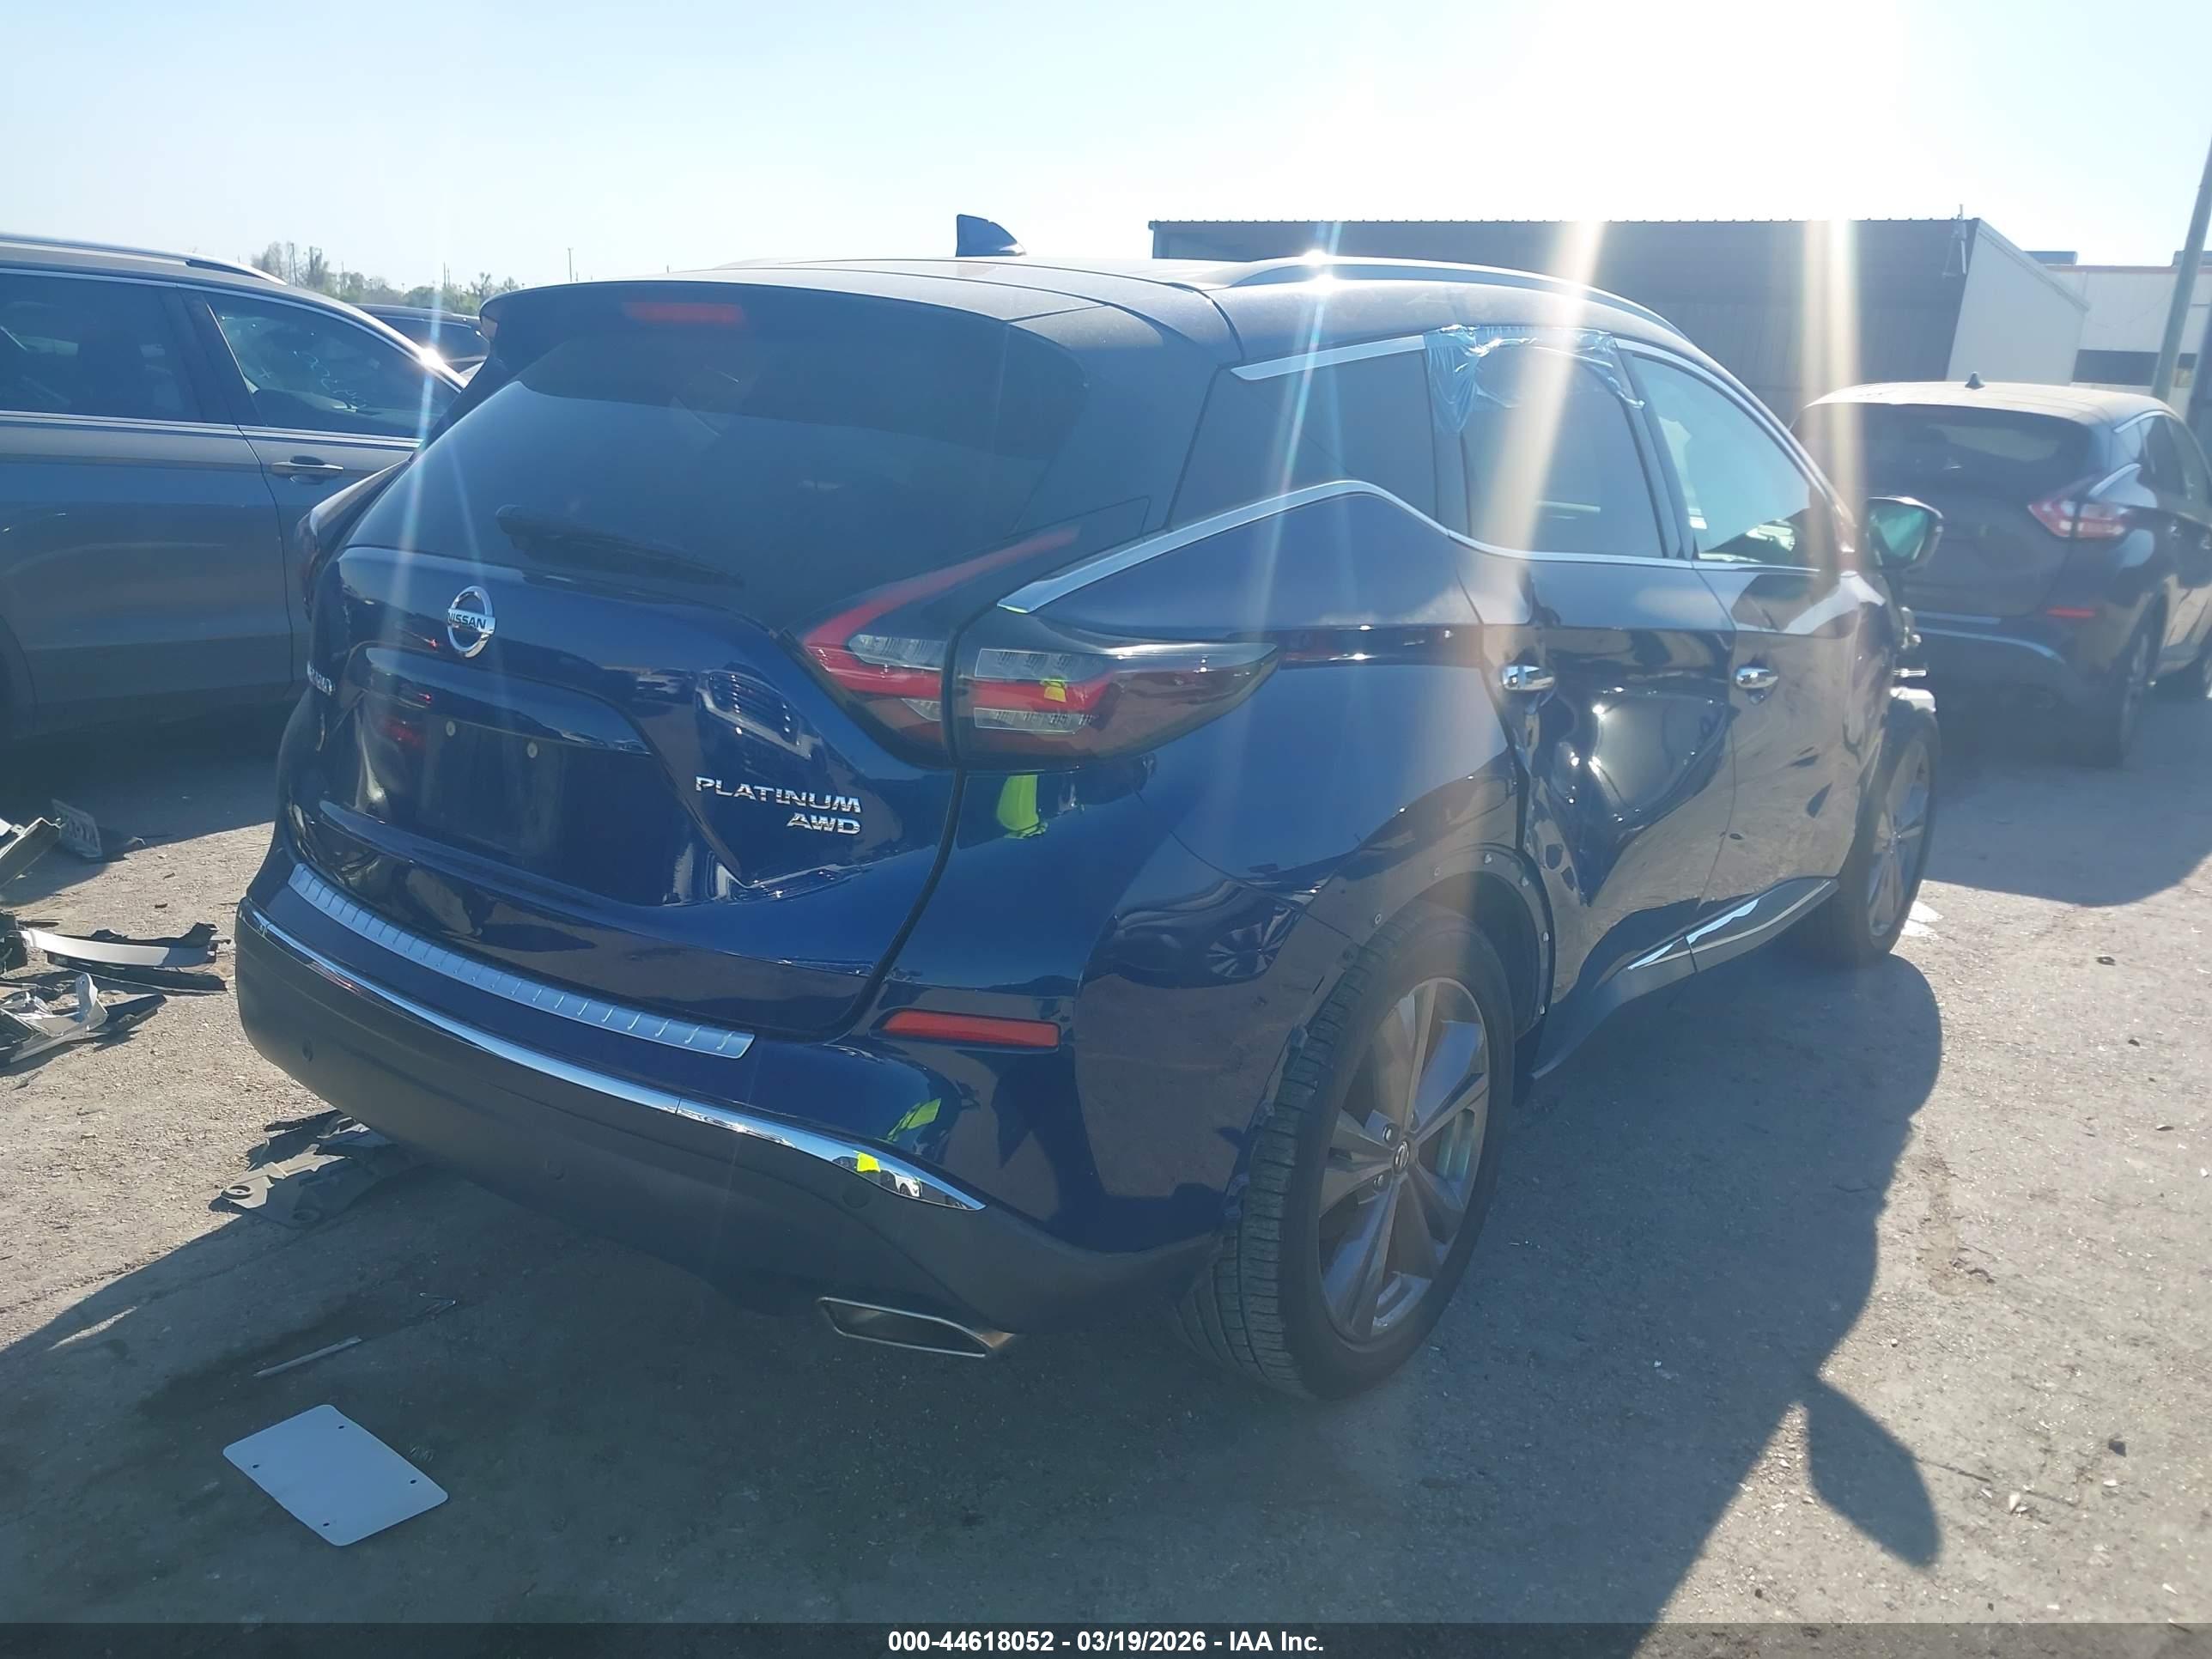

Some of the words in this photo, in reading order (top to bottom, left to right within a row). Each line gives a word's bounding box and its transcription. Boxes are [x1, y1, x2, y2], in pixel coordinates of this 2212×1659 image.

[447, 611, 487, 629] NISSAN
[695, 775, 862, 813] PLATINUM
[787, 812, 861, 836] AWD
